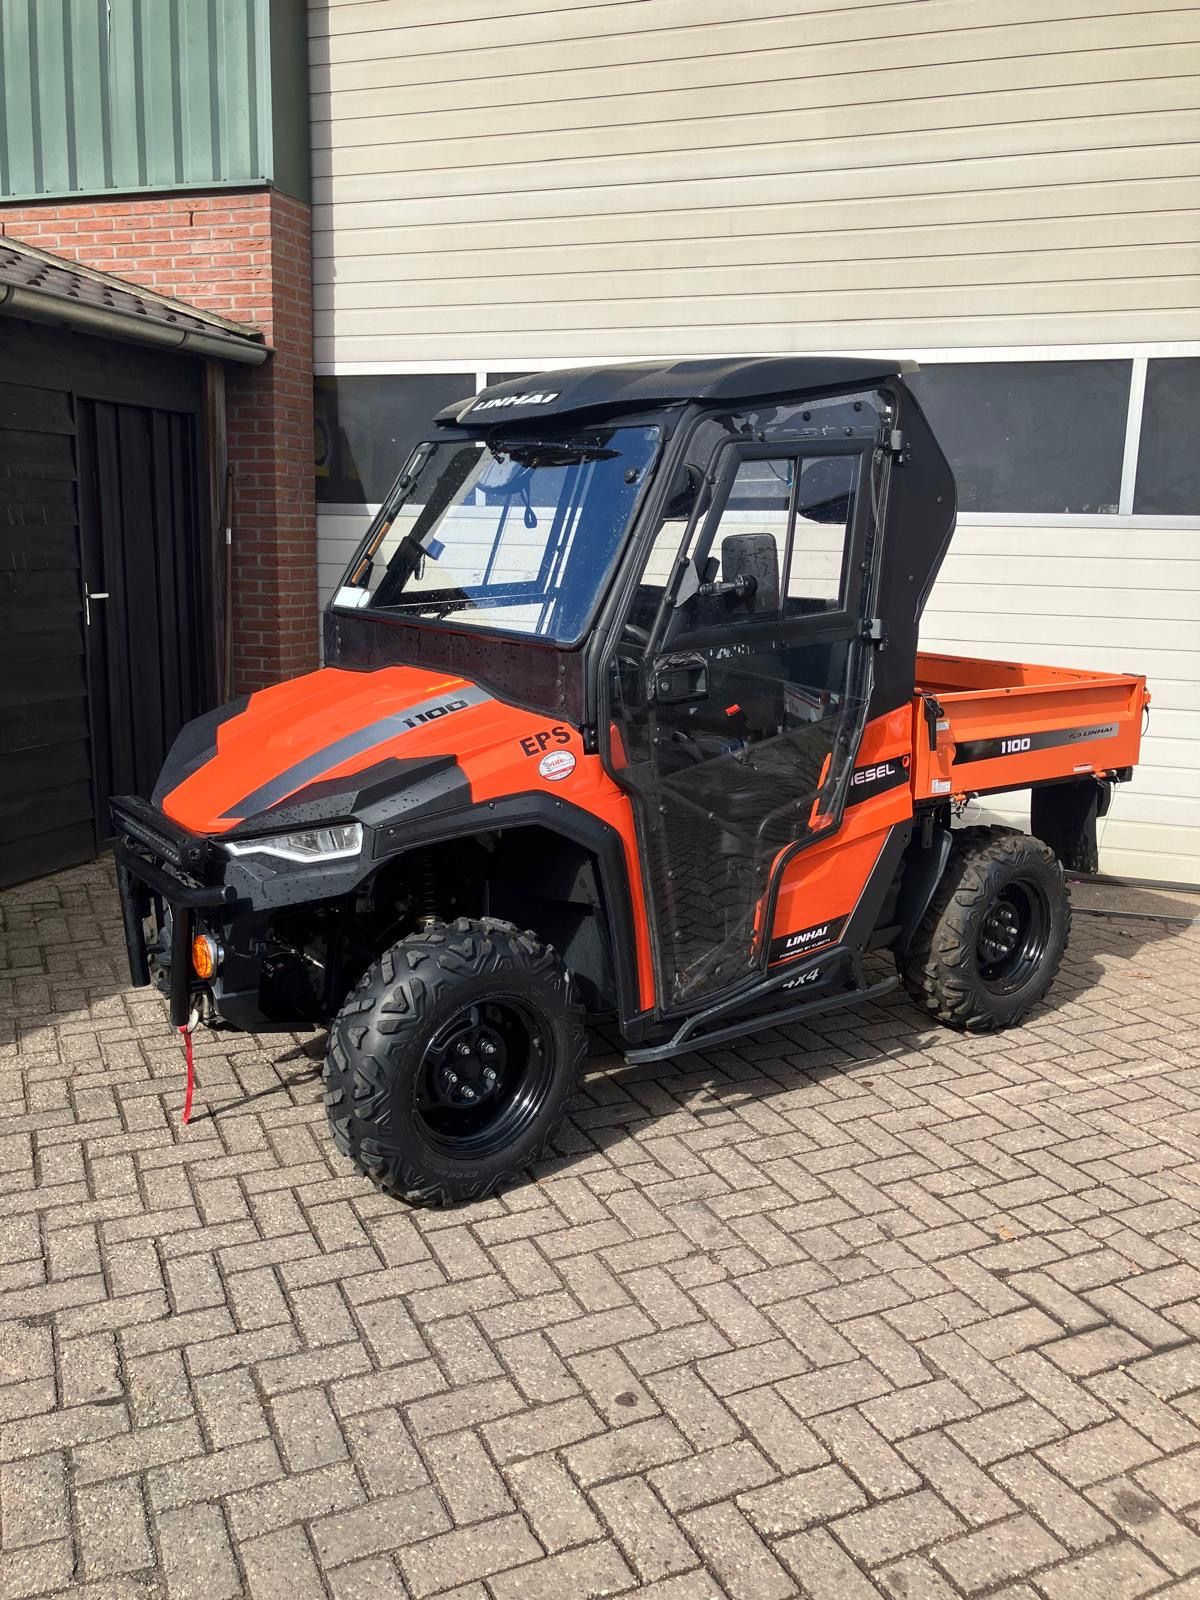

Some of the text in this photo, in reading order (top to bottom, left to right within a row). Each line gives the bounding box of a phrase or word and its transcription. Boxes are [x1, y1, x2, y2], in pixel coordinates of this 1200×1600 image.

[472, 393, 559, 411] LINHAI
[402, 699, 469, 728] 1100
[519, 726, 571, 756] EPS
[1083, 727, 1113, 737] LINHAI
[1001, 738, 1031, 754] 1100
[850, 763, 896, 786] IESEL
[785, 926, 828, 947] LINHAI
